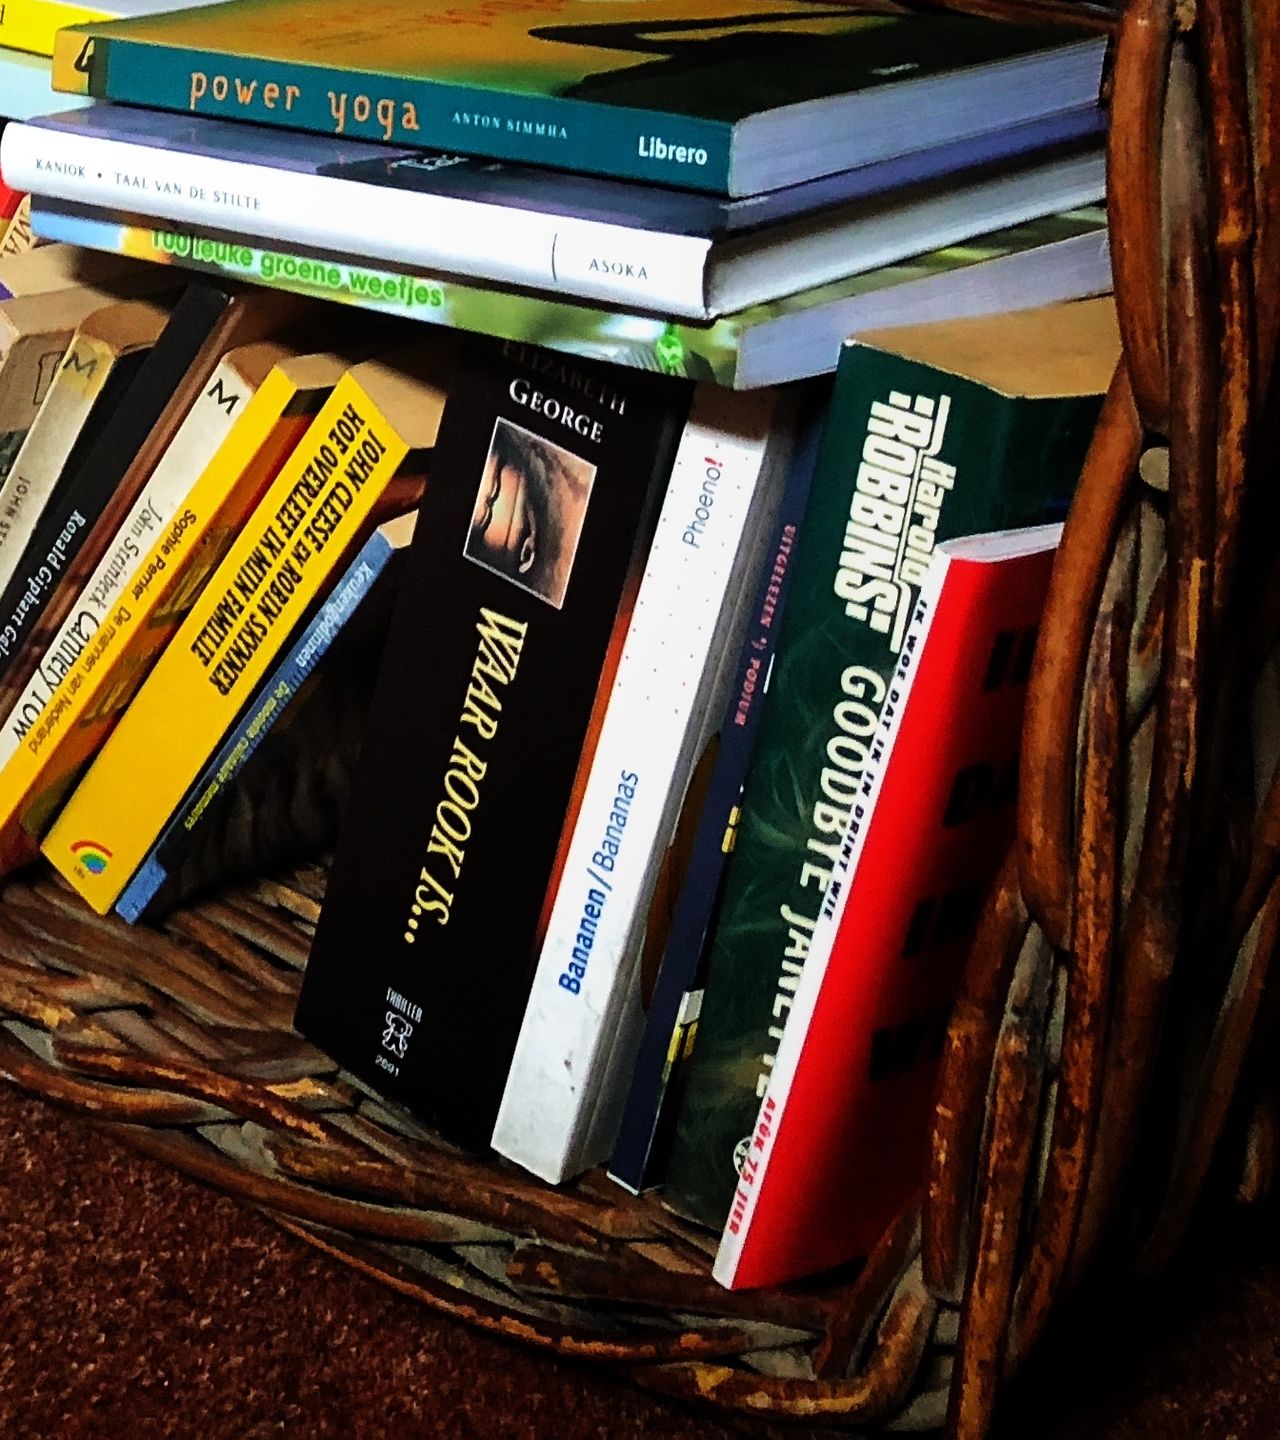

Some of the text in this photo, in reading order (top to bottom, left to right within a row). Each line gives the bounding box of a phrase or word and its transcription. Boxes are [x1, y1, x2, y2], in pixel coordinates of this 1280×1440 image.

[189, 72, 420, 141] power yoga
[452, 112, 500, 129] ANTON
[638, 135, 708, 165] Librero
[33, 158, 263, 211] KANIOK TAAL VAN DE STILTE
[255, 249, 342, 296] groene
[344, 265, 449, 314] weetjes
[589, 258, 648, 280] ASOKA
[508, 375, 604, 446] GEORGE
[335, 428, 387, 493] JOHN
[4, 475, 31, 518] JOHN
[298, 481, 354, 554] CLEESE
[681, 456, 724, 549] Phoeno!
[898, 456, 957, 588] Harold
[46, 509, 87, 570] Ronald
[190, 402, 366, 668] HOE OVERLEEF IK MIJN FAMILIE
[11, 566, 52, 626] Giphart
[37, 497, 163, 695] John Steinbeck Cannery
[249, 558, 303, 626] ROBIN
[734, 524, 796, 726] UITGELEZEN PODIUM
[909, 596, 928, 624] IK
[27, 509, 197, 755] Sophie Perrier De mannen van Nederland
[208, 613, 268, 696] SKYNNER
[897, 634, 918, 681] WOE
[460, 607, 529, 740] WAAR
[884, 688, 900, 718] DAT
[799, 664, 887, 893] GOODBYE
[861, 771, 875, 797] IN
[870, 739, 885, 763] IK
[421, 735, 488, 879] ROOK
[823, 880, 842, 920] WIE
[728, 1155, 759, 1236] 75 JIER
